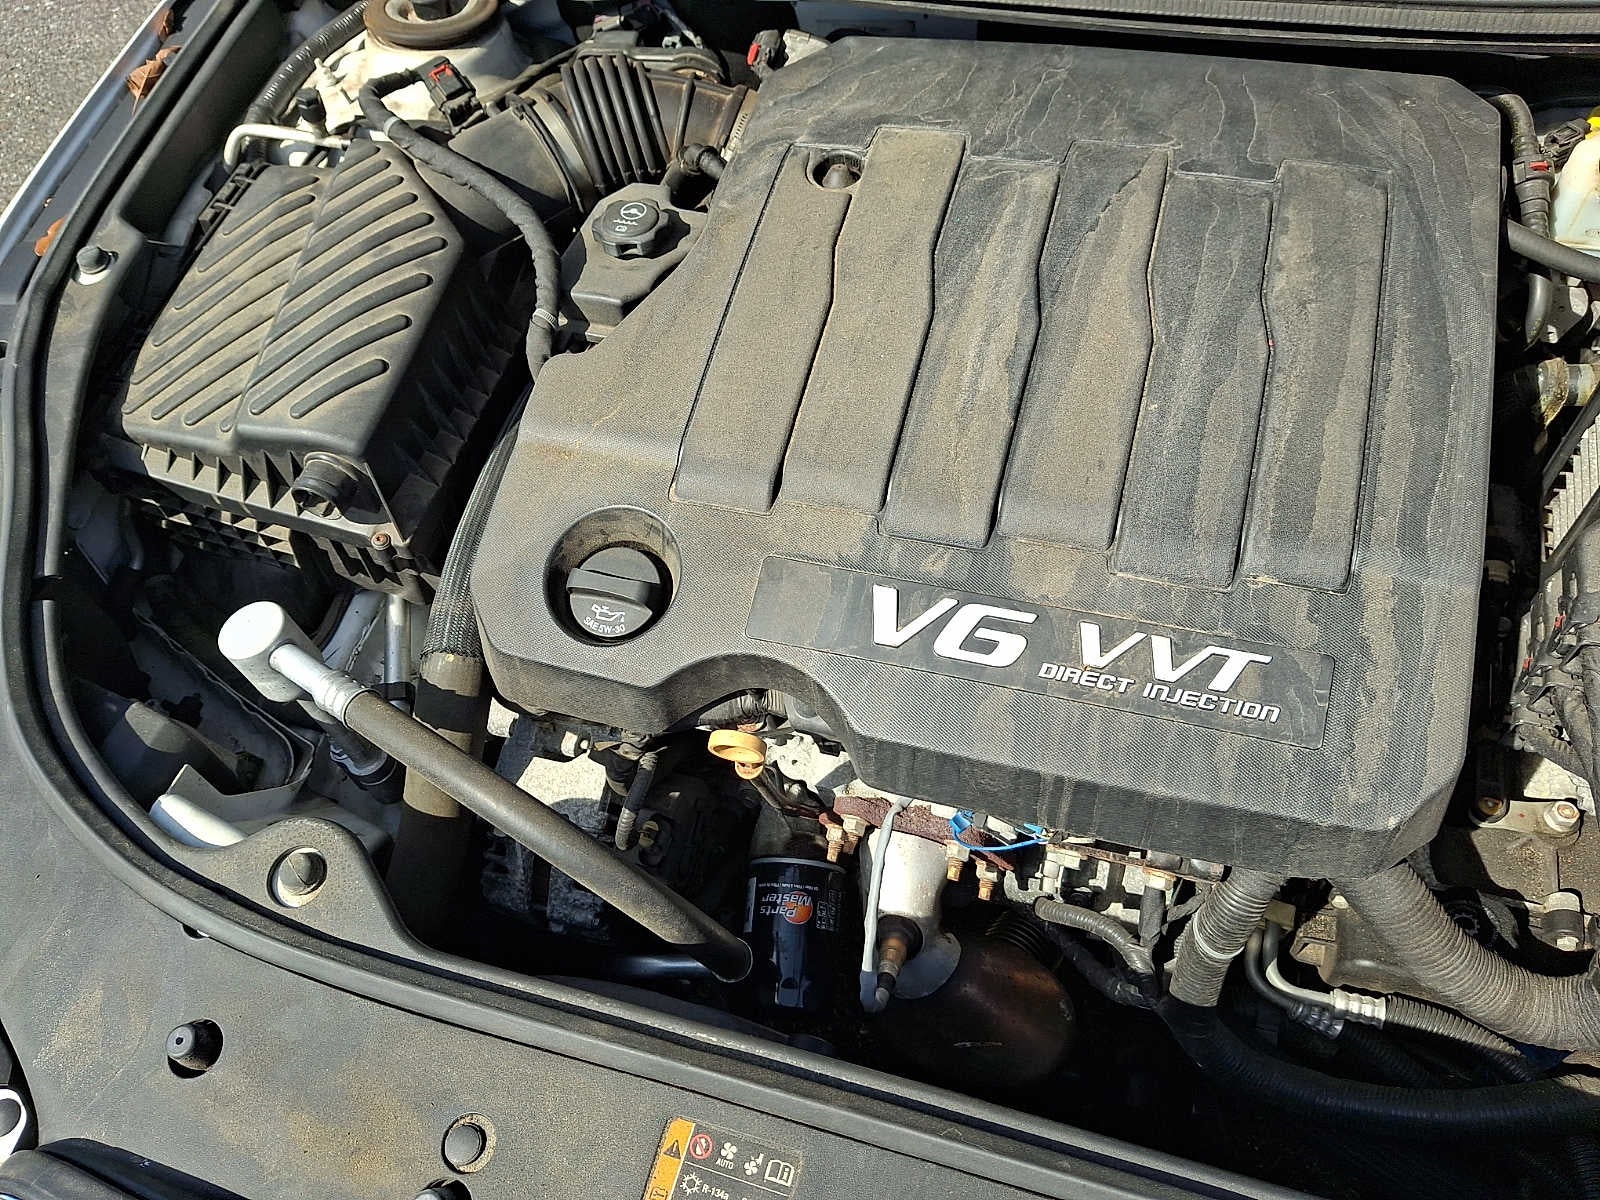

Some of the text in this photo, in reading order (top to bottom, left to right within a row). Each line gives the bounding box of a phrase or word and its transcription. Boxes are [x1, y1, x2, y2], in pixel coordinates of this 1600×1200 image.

[583, 616, 626, 634] SAE 5W-30
[873, 584, 1273, 692] V6 VVT
[1037, 662, 1282, 723] DIRECT INJECTION
[761, 893, 812, 906] Master
[760, 904, 798, 918] Parts
[715, 1158, 734, 1170] AUTO
[701, 1183, 729, 1200] R-134a
